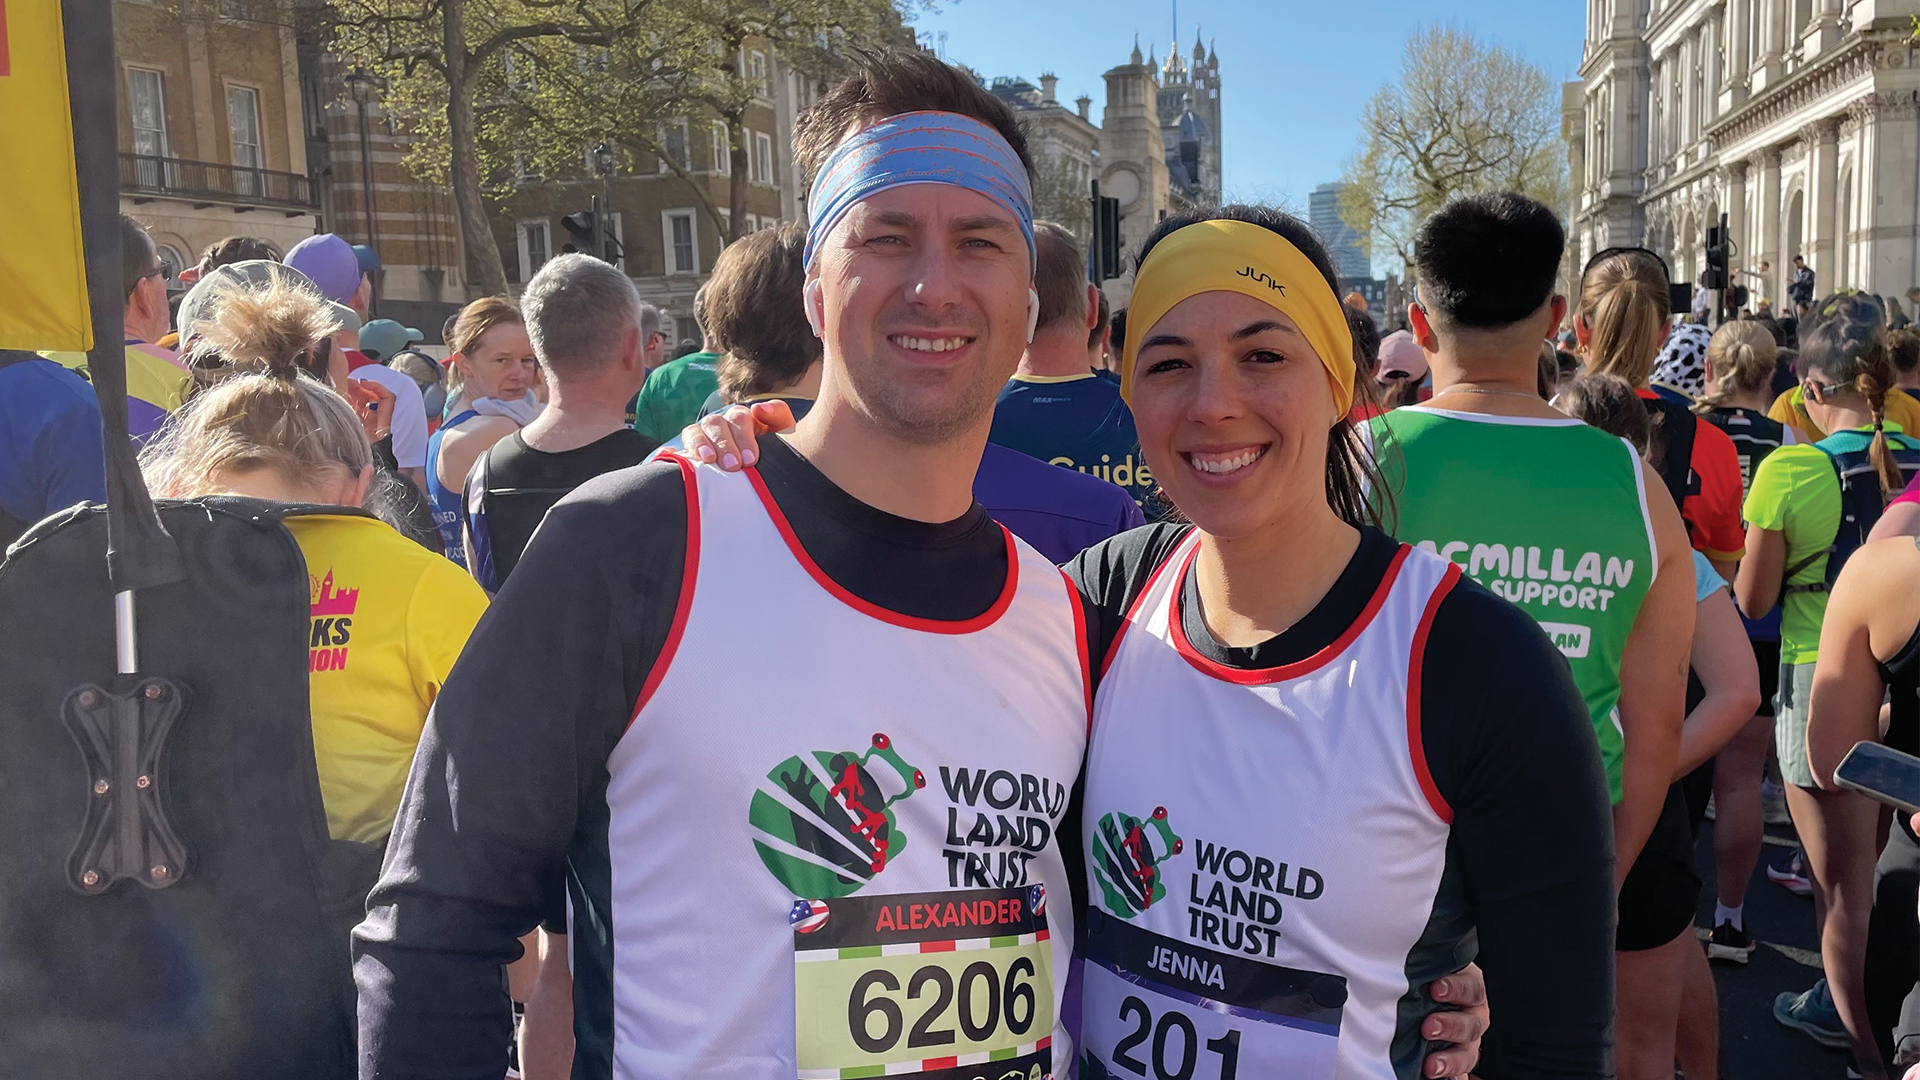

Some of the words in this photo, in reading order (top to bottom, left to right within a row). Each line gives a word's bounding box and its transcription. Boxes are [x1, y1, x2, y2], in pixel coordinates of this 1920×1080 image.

[1236, 266, 1286, 298] JUNK
[1491, 578, 1615, 613] SUPPORT
[939, 766, 1066, 820] WORLD
[946, 807, 1051, 852] LAND
[942, 849, 1038, 889] TRUST
[1195, 838, 1325, 900] WORLD
[876, 898, 1022, 932] ALEXANDER
[1190, 873, 1283, 926] LAND
[1188, 906, 1281, 958] TRUST
[1147, 945, 1226, 991] JENNA
[848, 956, 1036, 1054] 6206
[1112, 995, 1242, 1080] 201
